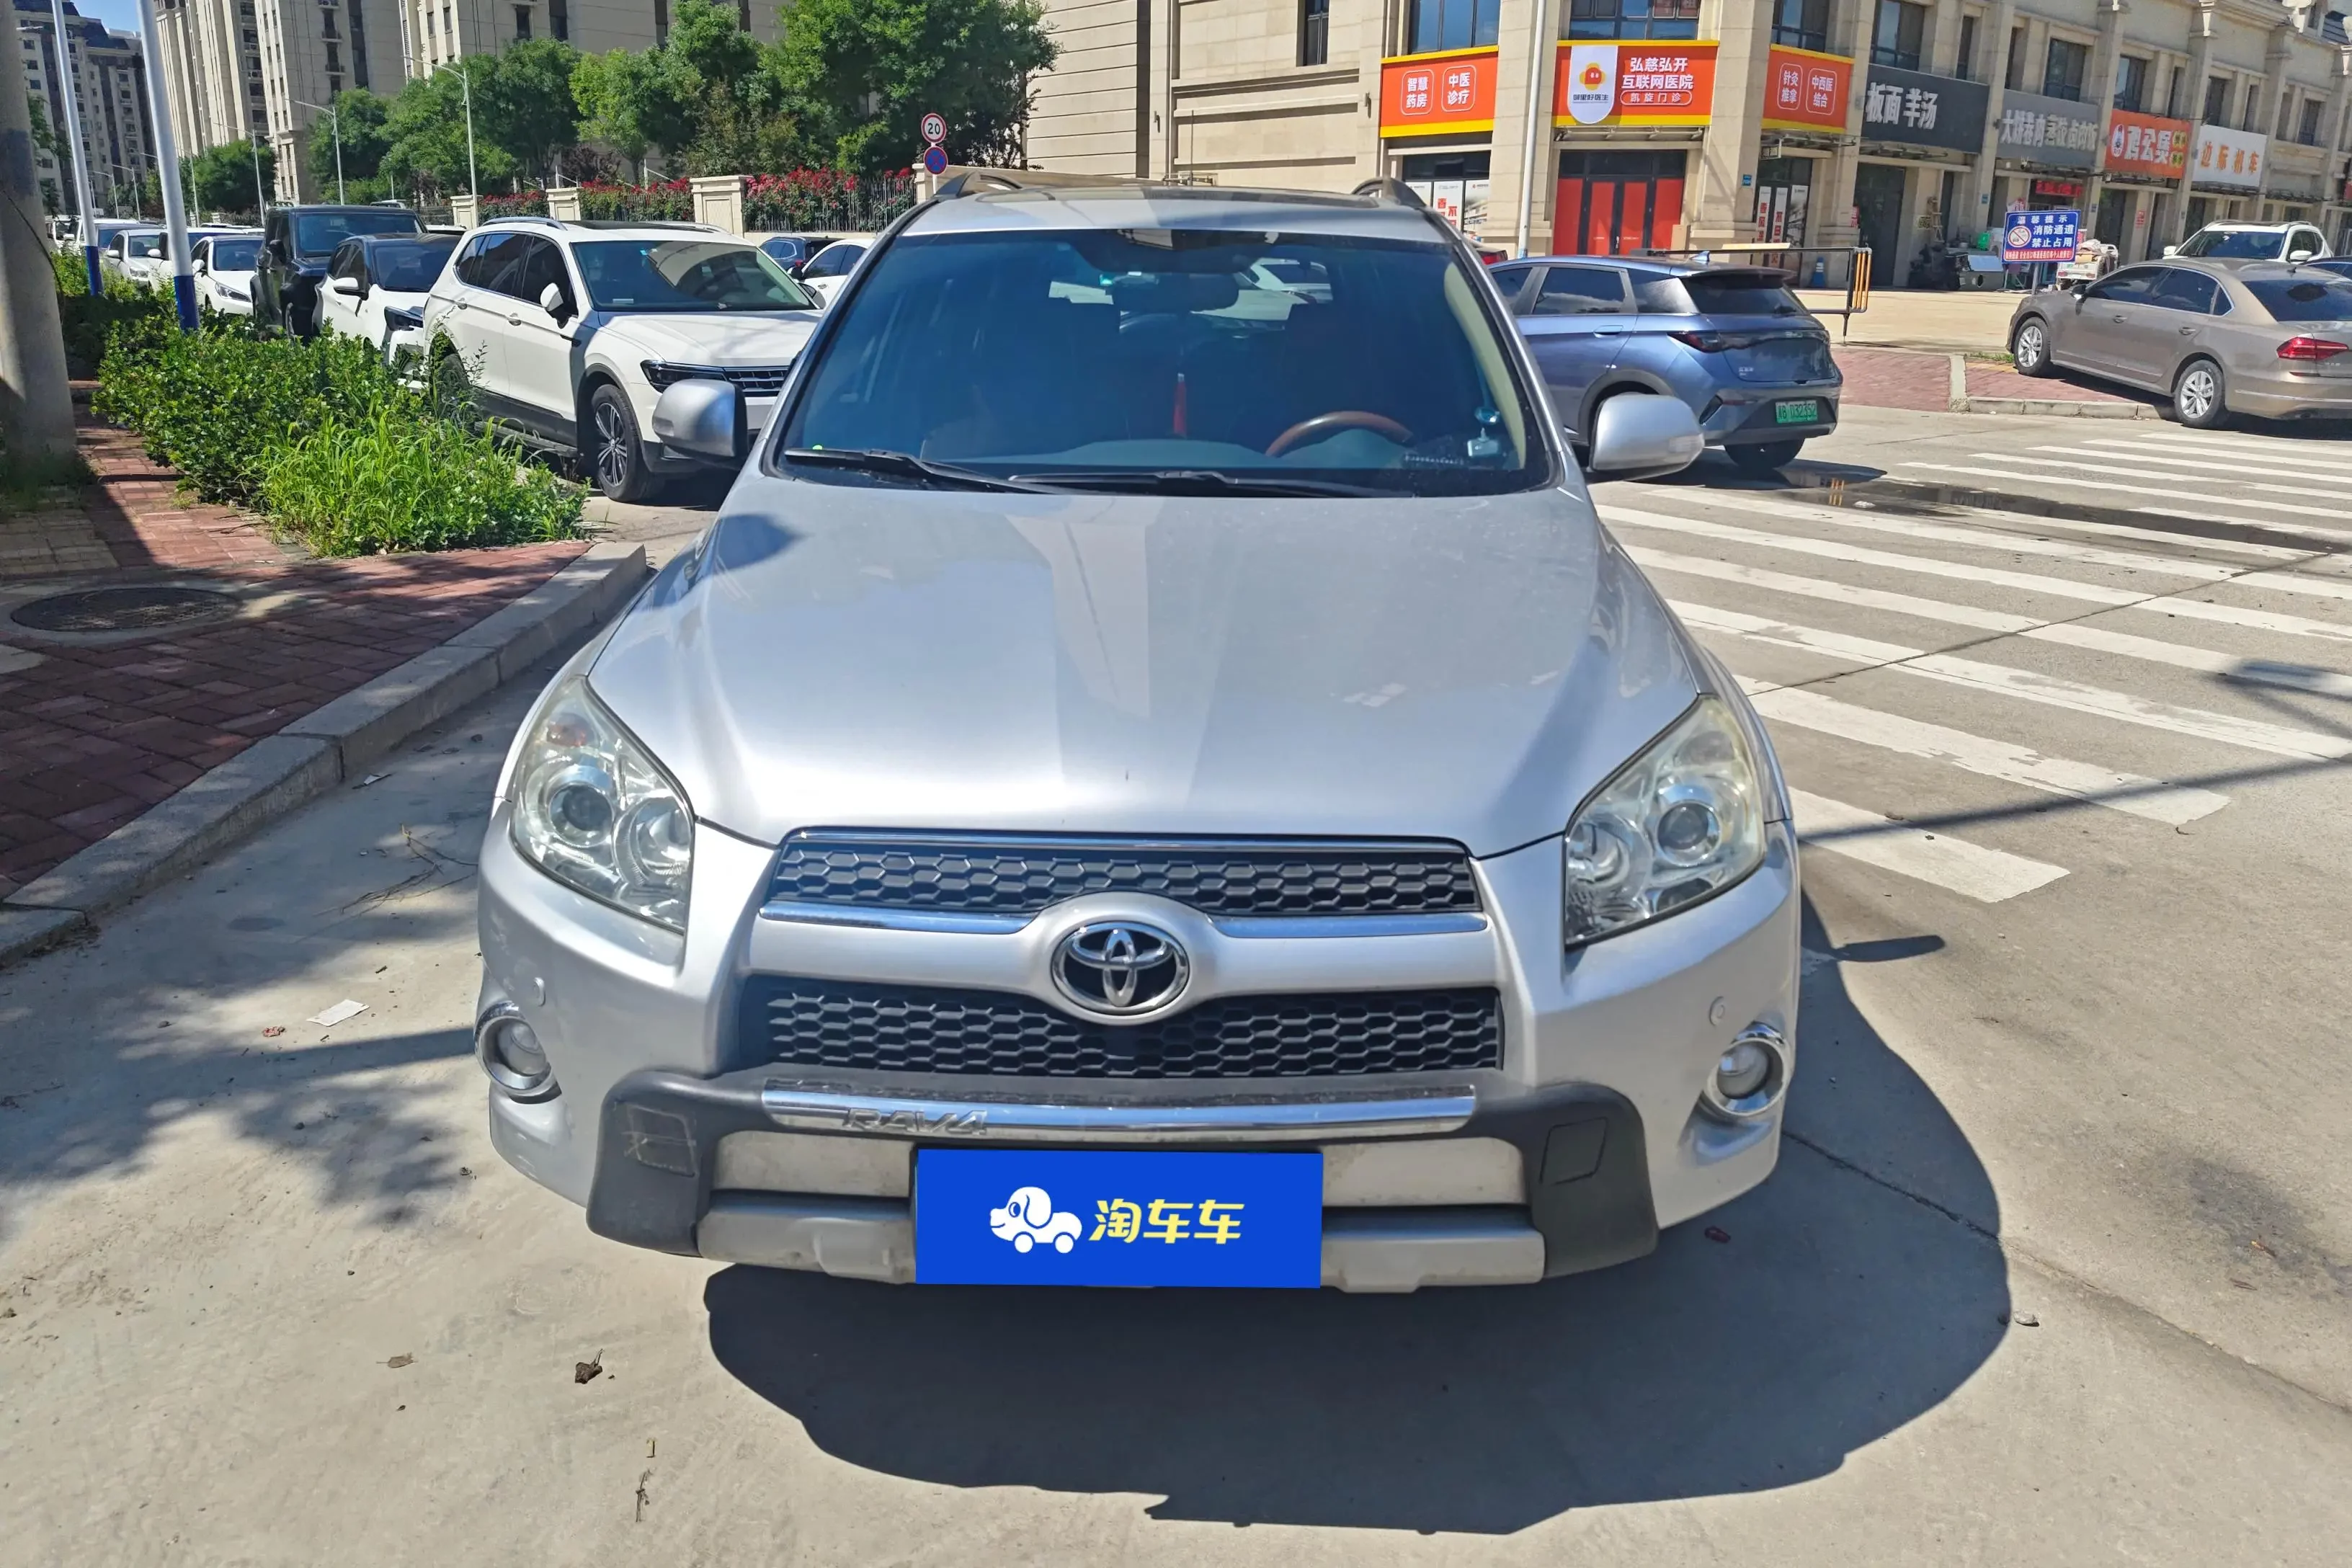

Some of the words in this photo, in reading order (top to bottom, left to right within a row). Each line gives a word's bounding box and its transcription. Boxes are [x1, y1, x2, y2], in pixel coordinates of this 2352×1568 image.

[1630, 57, 1688, 73] 弘慈弘开
[1407, 76, 1429, 92] 智慧
[1448, 72, 1471, 88] 中医
[1622, 74, 1695, 89] 互联网医院
[1783, 70, 1799, 86] 针灸
[1812, 74, 1833, 92] 中西医
[1406, 92, 1427, 109] 药房
[1447, 89, 1470, 105] 诊疗
[1630, 92, 1682, 102] 凯旋门诊
[1781, 86, 1797, 104] 推拿
[1812, 92, 1828, 108] 结合
[1866, 82, 1938, 130] 板面羊汤
[927, 122, 940, 135] 20
[2017, 215, 2067, 224] 温馨提示
[2033, 225, 2075, 235] 消防通道
[2031, 237, 2072, 248] 禁止占用
[842, 1107, 987, 1136] RAV4
